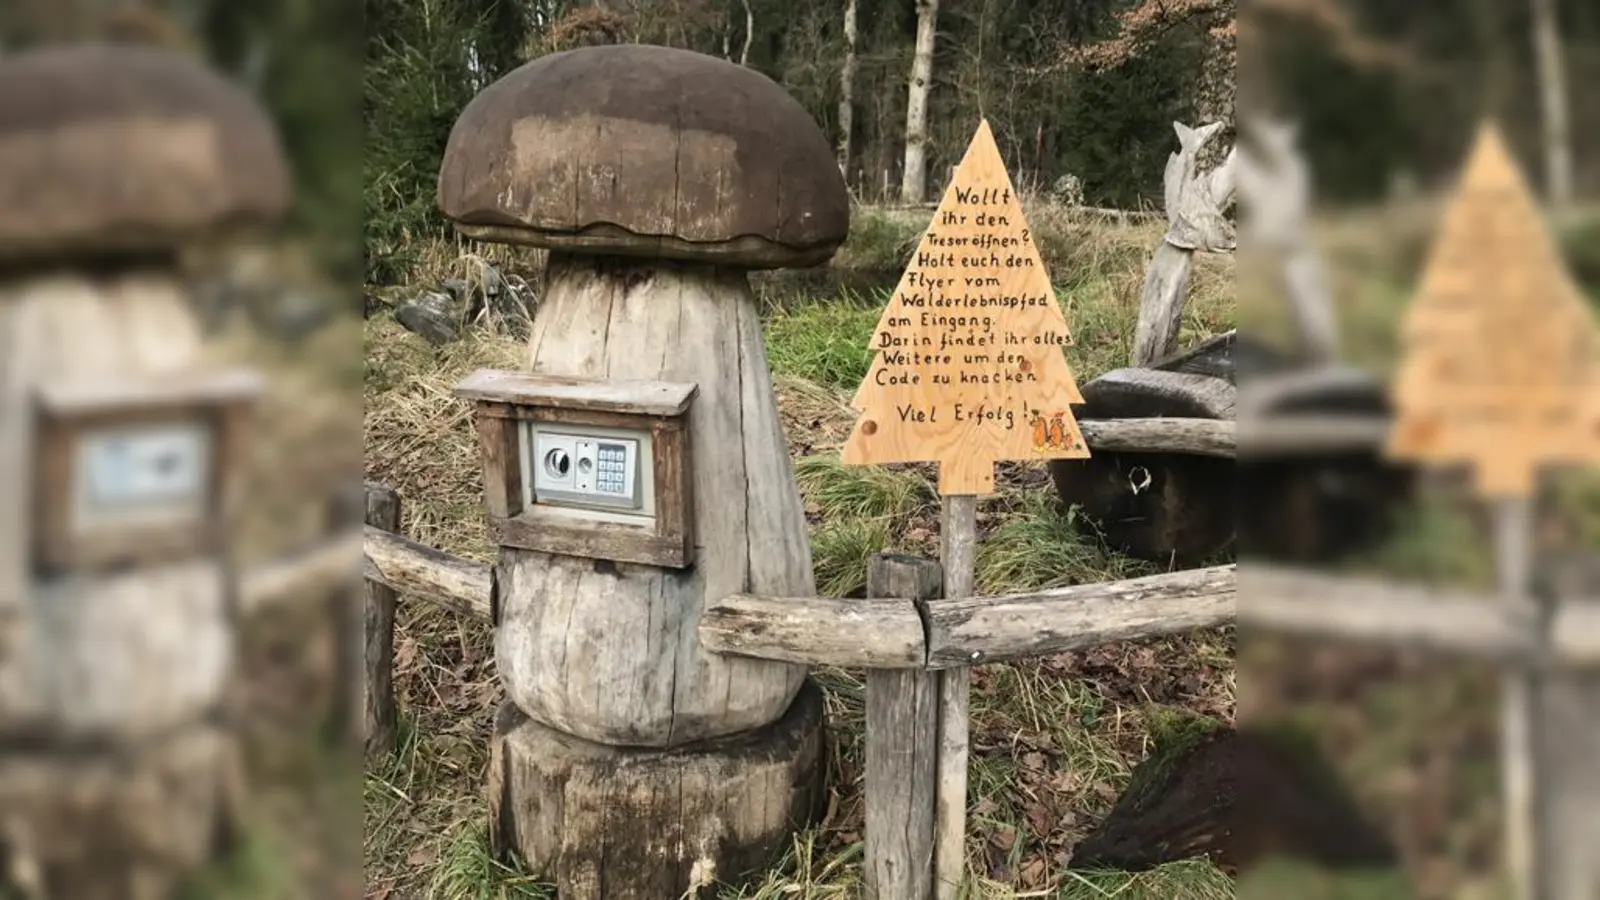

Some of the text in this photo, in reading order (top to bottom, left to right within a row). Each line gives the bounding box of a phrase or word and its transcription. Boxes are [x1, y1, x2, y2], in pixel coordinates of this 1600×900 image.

[955, 187, 1011, 206] Wollt
[942, 211, 1009, 226] ihr den
[918, 252, 1034, 268] Holt euch den
[908, 272, 1000, 291] Flyer vom
[901, 293, 1049, 310] Walderlebnispfad
[888, 312, 996, 333] am Eingang.
[878, 331, 1071, 350] Darin findet ihr alles
[883, 350, 1025, 366] Weitere um den
[875, 368, 1037, 386] Code zu knacken
[896, 403, 937, 423] Viel
